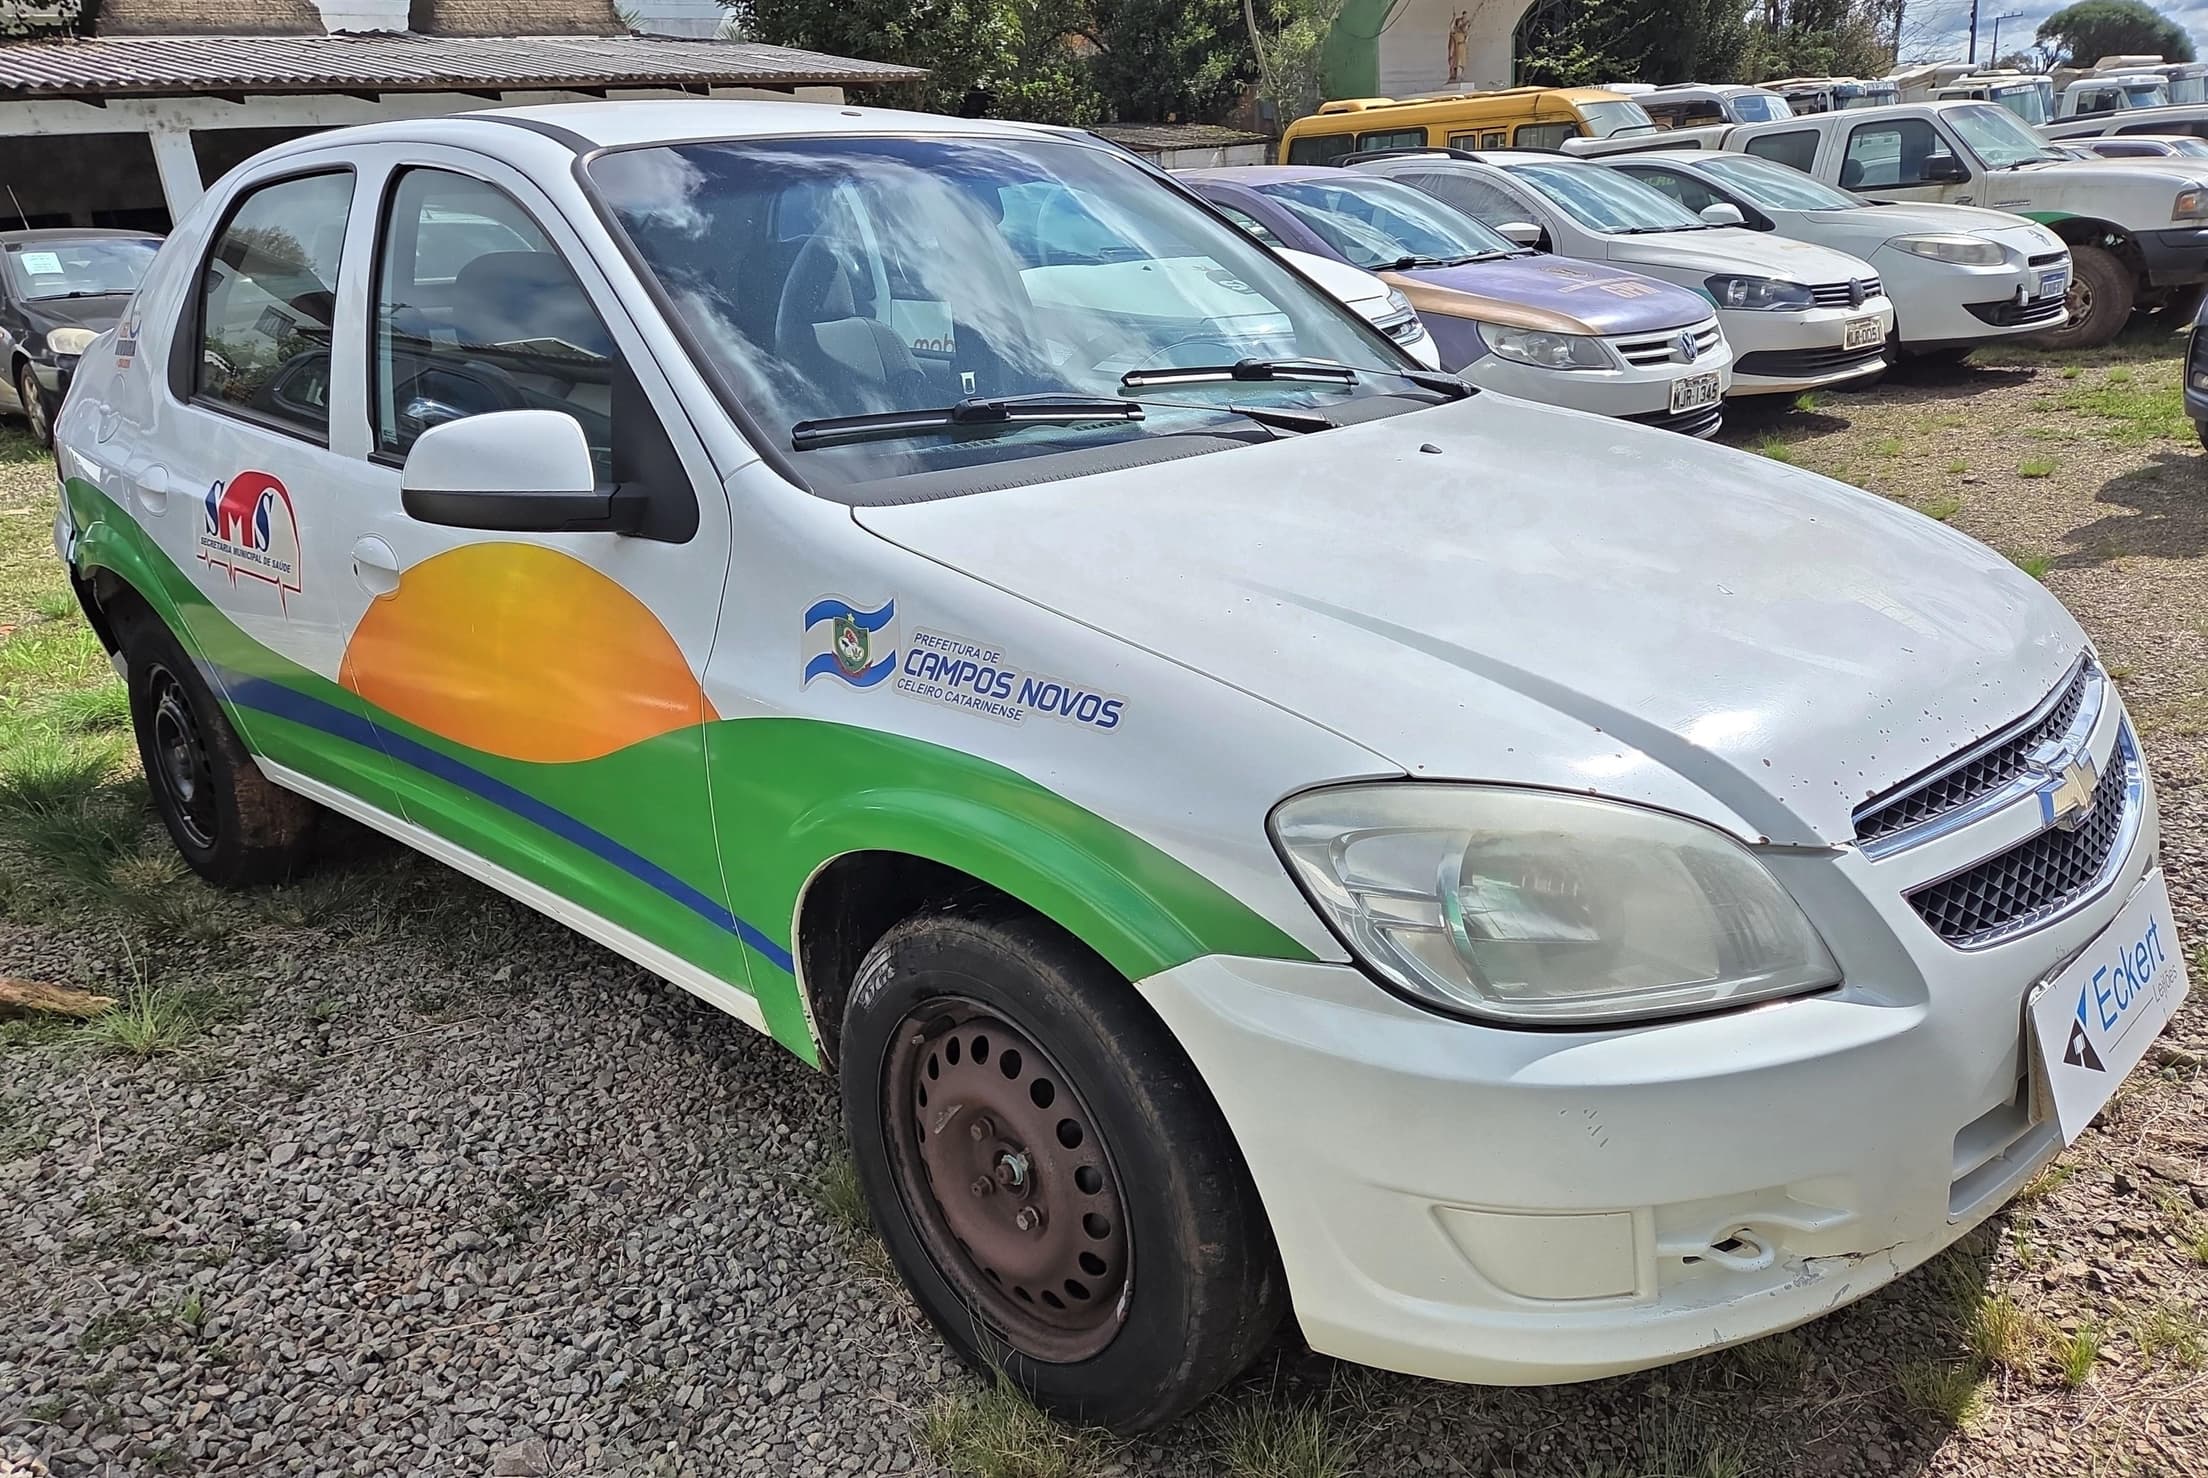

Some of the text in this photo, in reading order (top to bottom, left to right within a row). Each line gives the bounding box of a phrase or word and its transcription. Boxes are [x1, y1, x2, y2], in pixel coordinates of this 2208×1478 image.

[204, 470, 278, 553] SMS
[201, 536, 232, 554] SECRETARIA
[232, 547, 262, 564] MUNICIPAL
[263, 556, 271, 567] DE
[913, 632, 1000, 664] PREFEITURA DE
[896, 677, 1024, 722] CELEIRO CATARINENSE
[903, 648, 1124, 729] CAMPOS NOVOS
[2091, 913, 2166, 1032] Eckert
